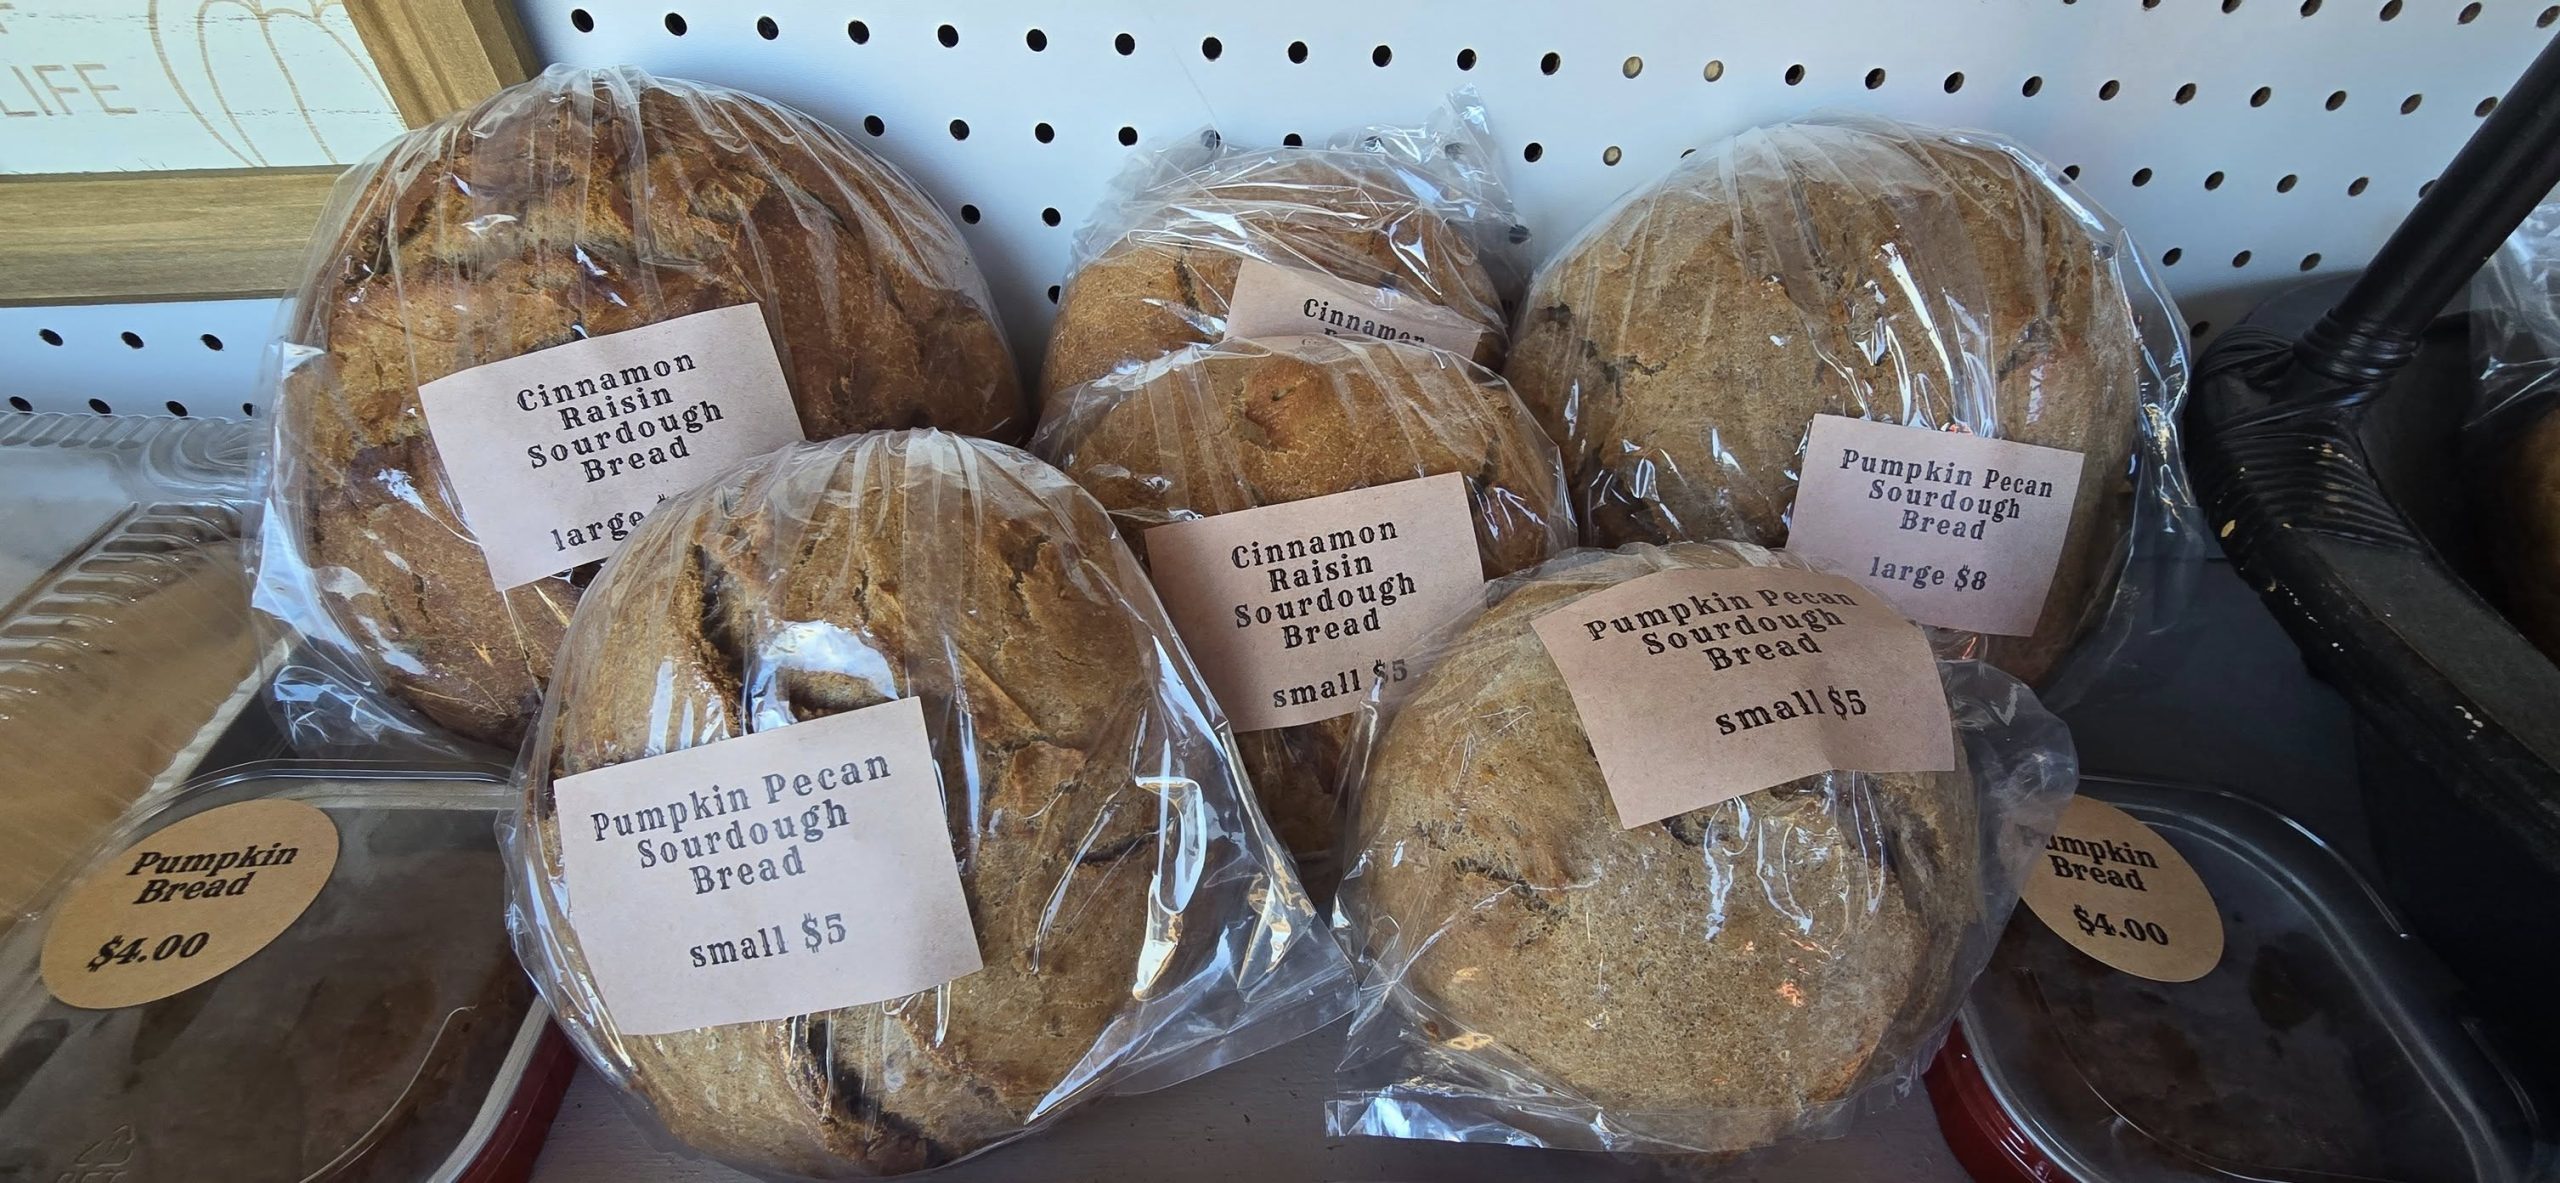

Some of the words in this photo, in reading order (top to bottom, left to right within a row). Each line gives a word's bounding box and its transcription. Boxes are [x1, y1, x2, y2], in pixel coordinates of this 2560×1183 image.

[517, 353, 697, 412] Cinnamon
[557, 386, 674, 430] Raisin
[526, 400, 724, 469] Sourdough
[581, 435, 690, 483] Bread
[1839, 448, 1973, 487] Pumpkin
[1982, 468, 2053, 498] Pecan
[1868, 479, 2021, 523] Sourdough
[550, 511, 645, 552] large
[1231, 521, 1399, 569] Cinnamon
[1899, 509, 1987, 540] Bread
[1267, 553, 1374, 593] Raisin
[1869, 556, 1945, 589] large
[1954, 564, 1988, 592] $8
[1235, 572, 1417, 629] Sourdough
[1583, 591, 1754, 641] Pumpkin
[1756, 588, 1859, 608] Pecan
[1281, 607, 1381, 649] Bread
[1642, 607, 1847, 656] Sourdough
[1702, 632, 1823, 671] Bread
[1273, 668, 1362, 708] small
[1373, 658, 1408, 690] $5
[1715, 689, 1825, 736] small
[1828, 685, 1868, 721] $5
[590, 784, 752, 842] Pumpkin
[761, 754, 892, 804] Pecan
[637, 798, 850, 869] Sourdough
[2045, 834, 2160, 869] umpkin
[125, 842, 300, 877] Pumpkin
[689, 845, 806, 895] Bread
[2048, 853, 2148, 892] Bread
[132, 872, 256, 904] Bread
[689, 924, 789, 968] small
[801, 912, 848, 953] $5
[2073, 903, 2170, 946] $4.00
[86, 931, 210, 972] $4.00
